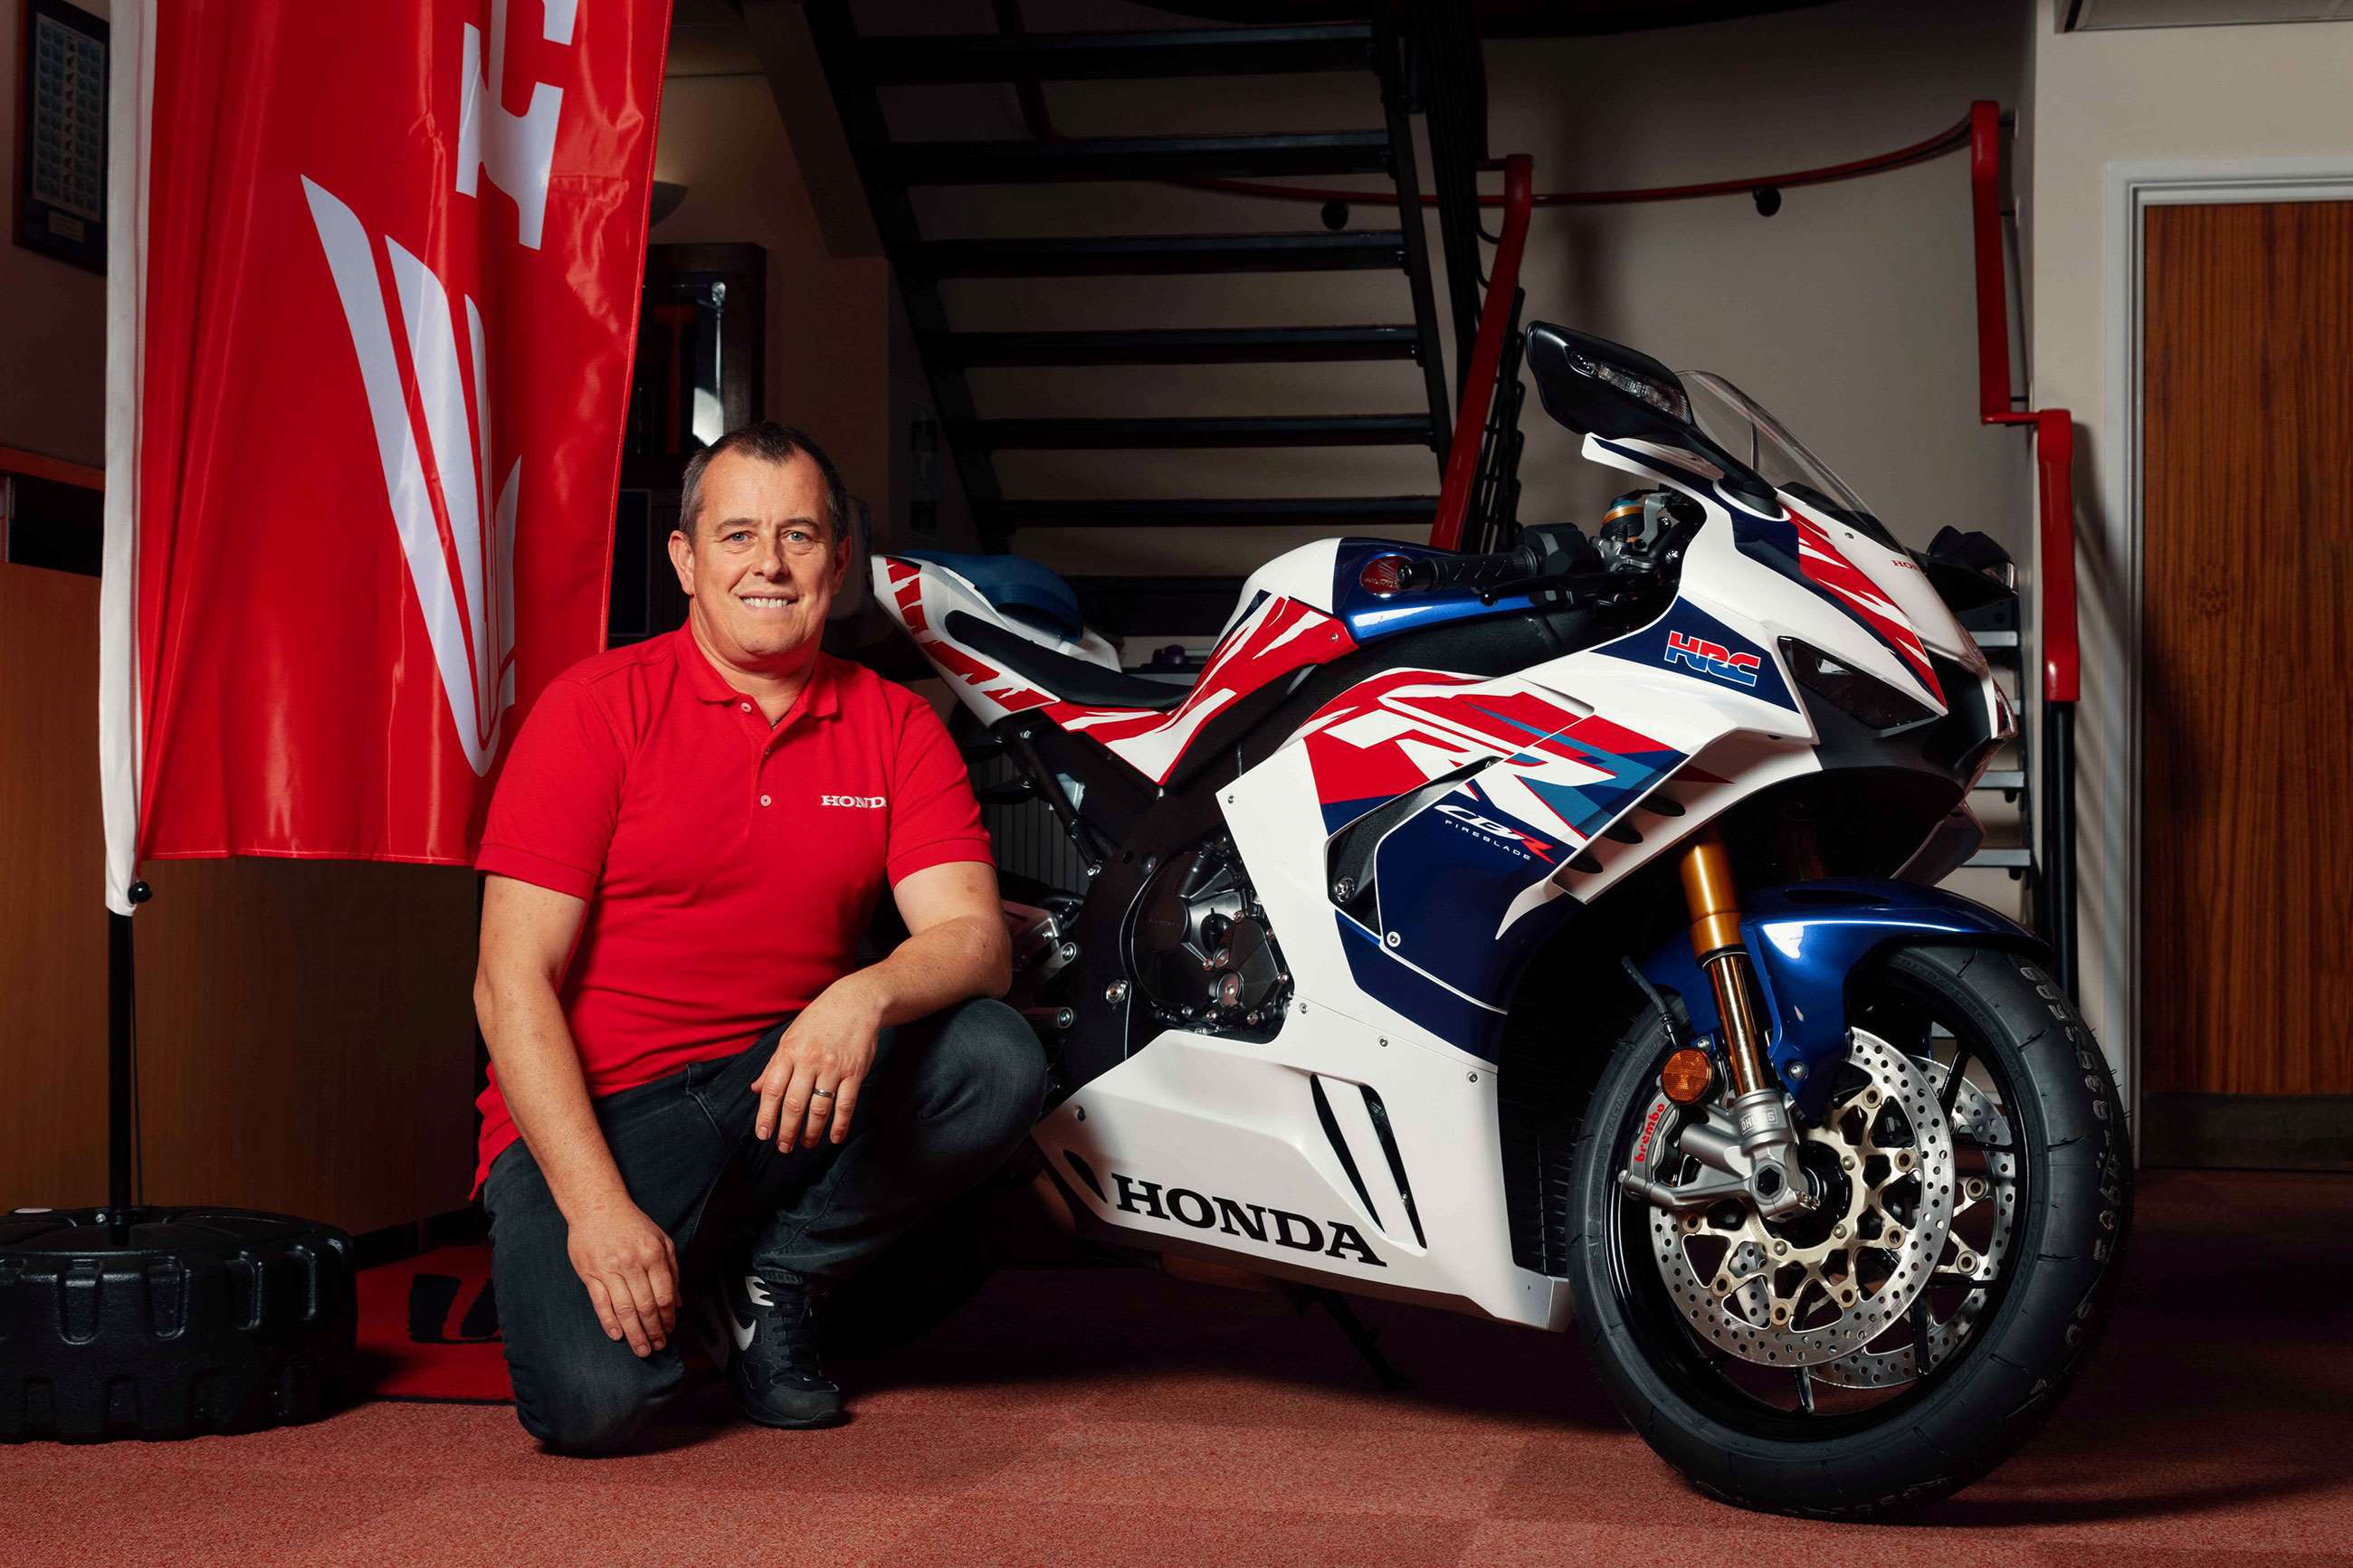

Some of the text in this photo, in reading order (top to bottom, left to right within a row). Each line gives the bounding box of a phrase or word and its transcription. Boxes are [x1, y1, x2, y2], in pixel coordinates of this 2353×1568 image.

[1664, 630, 1761, 687] HRC
[821, 795, 887, 808] HOND
[1434, 804, 1556, 864] CBR
[1444, 819, 1531, 860] FIREBLADE
[1634, 1103, 1665, 1163] brembo
[1111, 1173, 1387, 1268] HONDA
